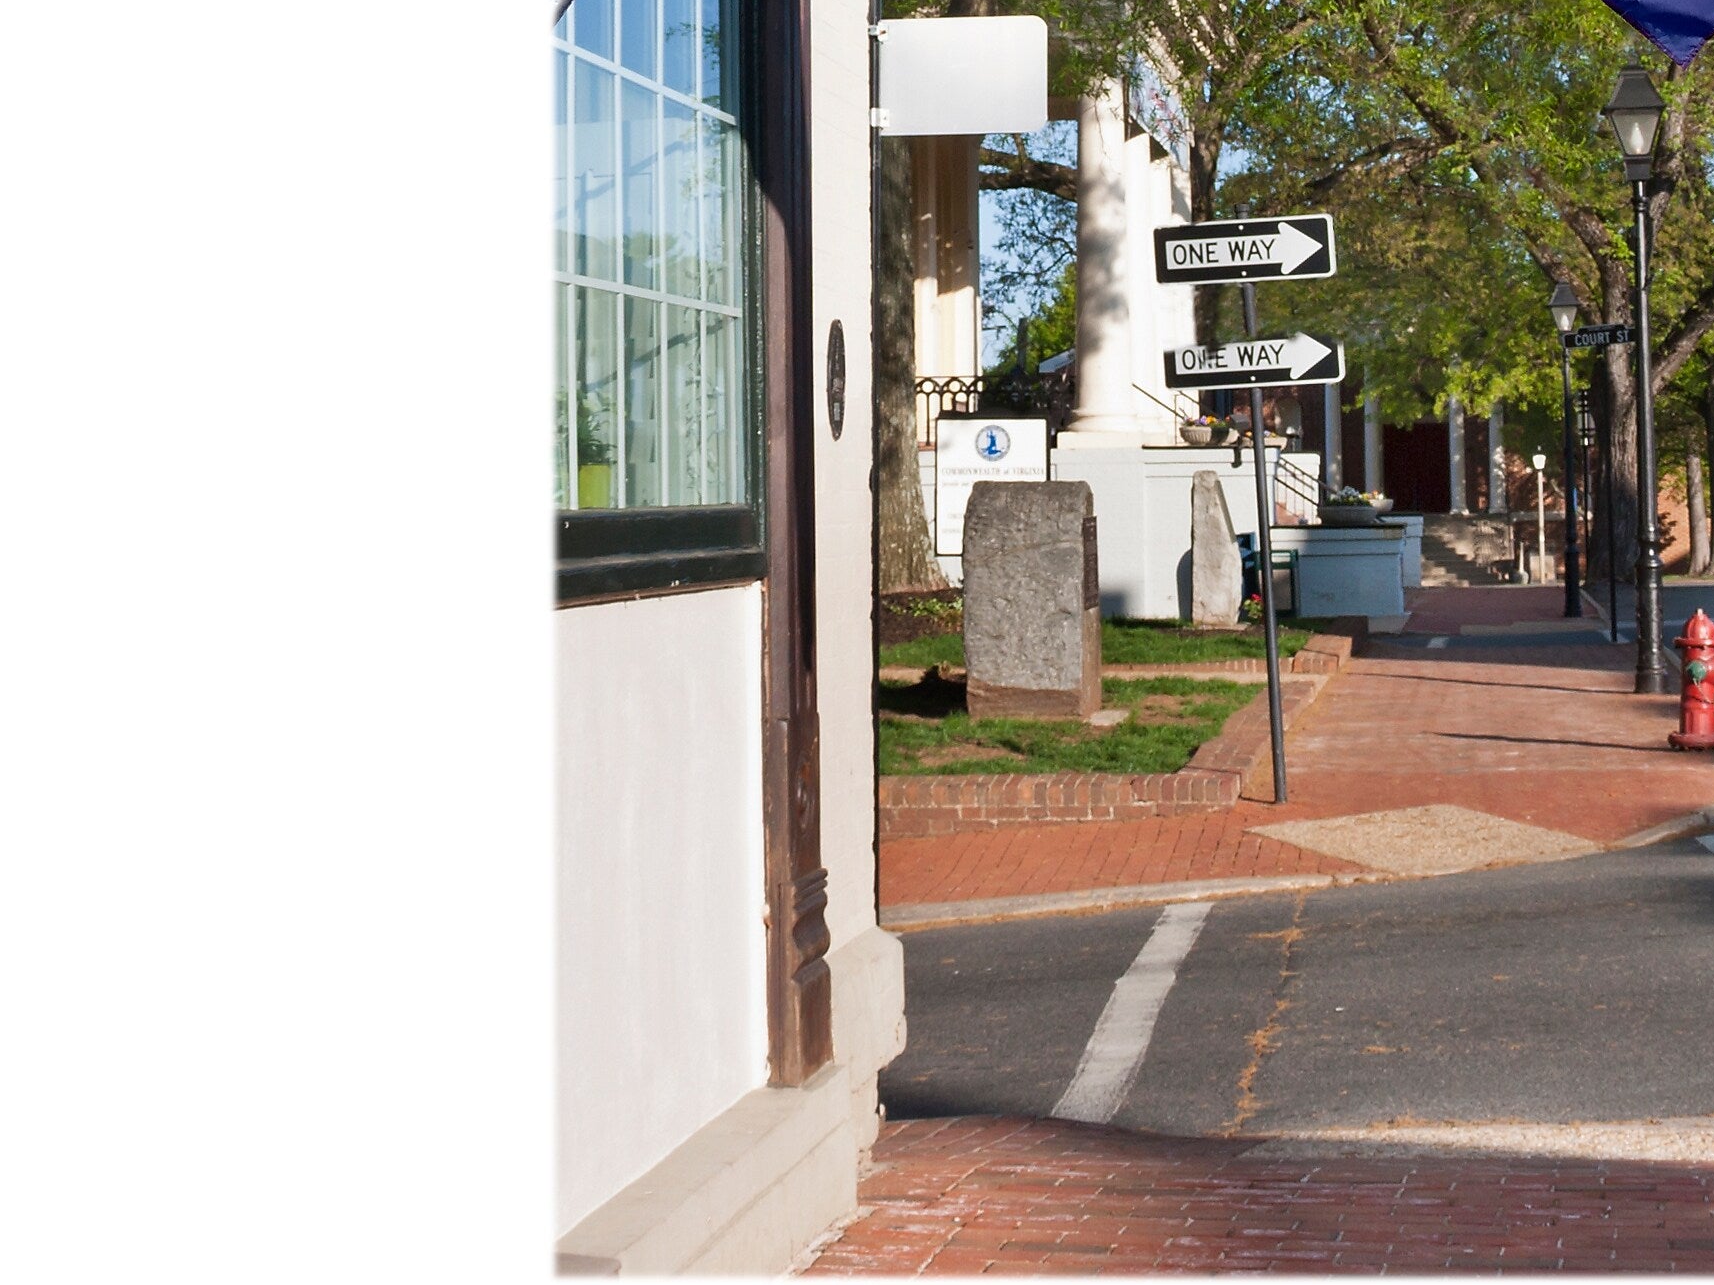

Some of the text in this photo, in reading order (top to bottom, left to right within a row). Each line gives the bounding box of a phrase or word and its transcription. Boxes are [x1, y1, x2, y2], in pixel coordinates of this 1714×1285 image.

[1173, 239, 1276, 265] ONE WAY
[1574, 330, 1630, 346] COURT ST
[1237, 344, 1285, 367] WAY
[941, 467, 1000, 475] COMMONWEALTH
[1013, 466, 1044, 475] VIRGINIA
